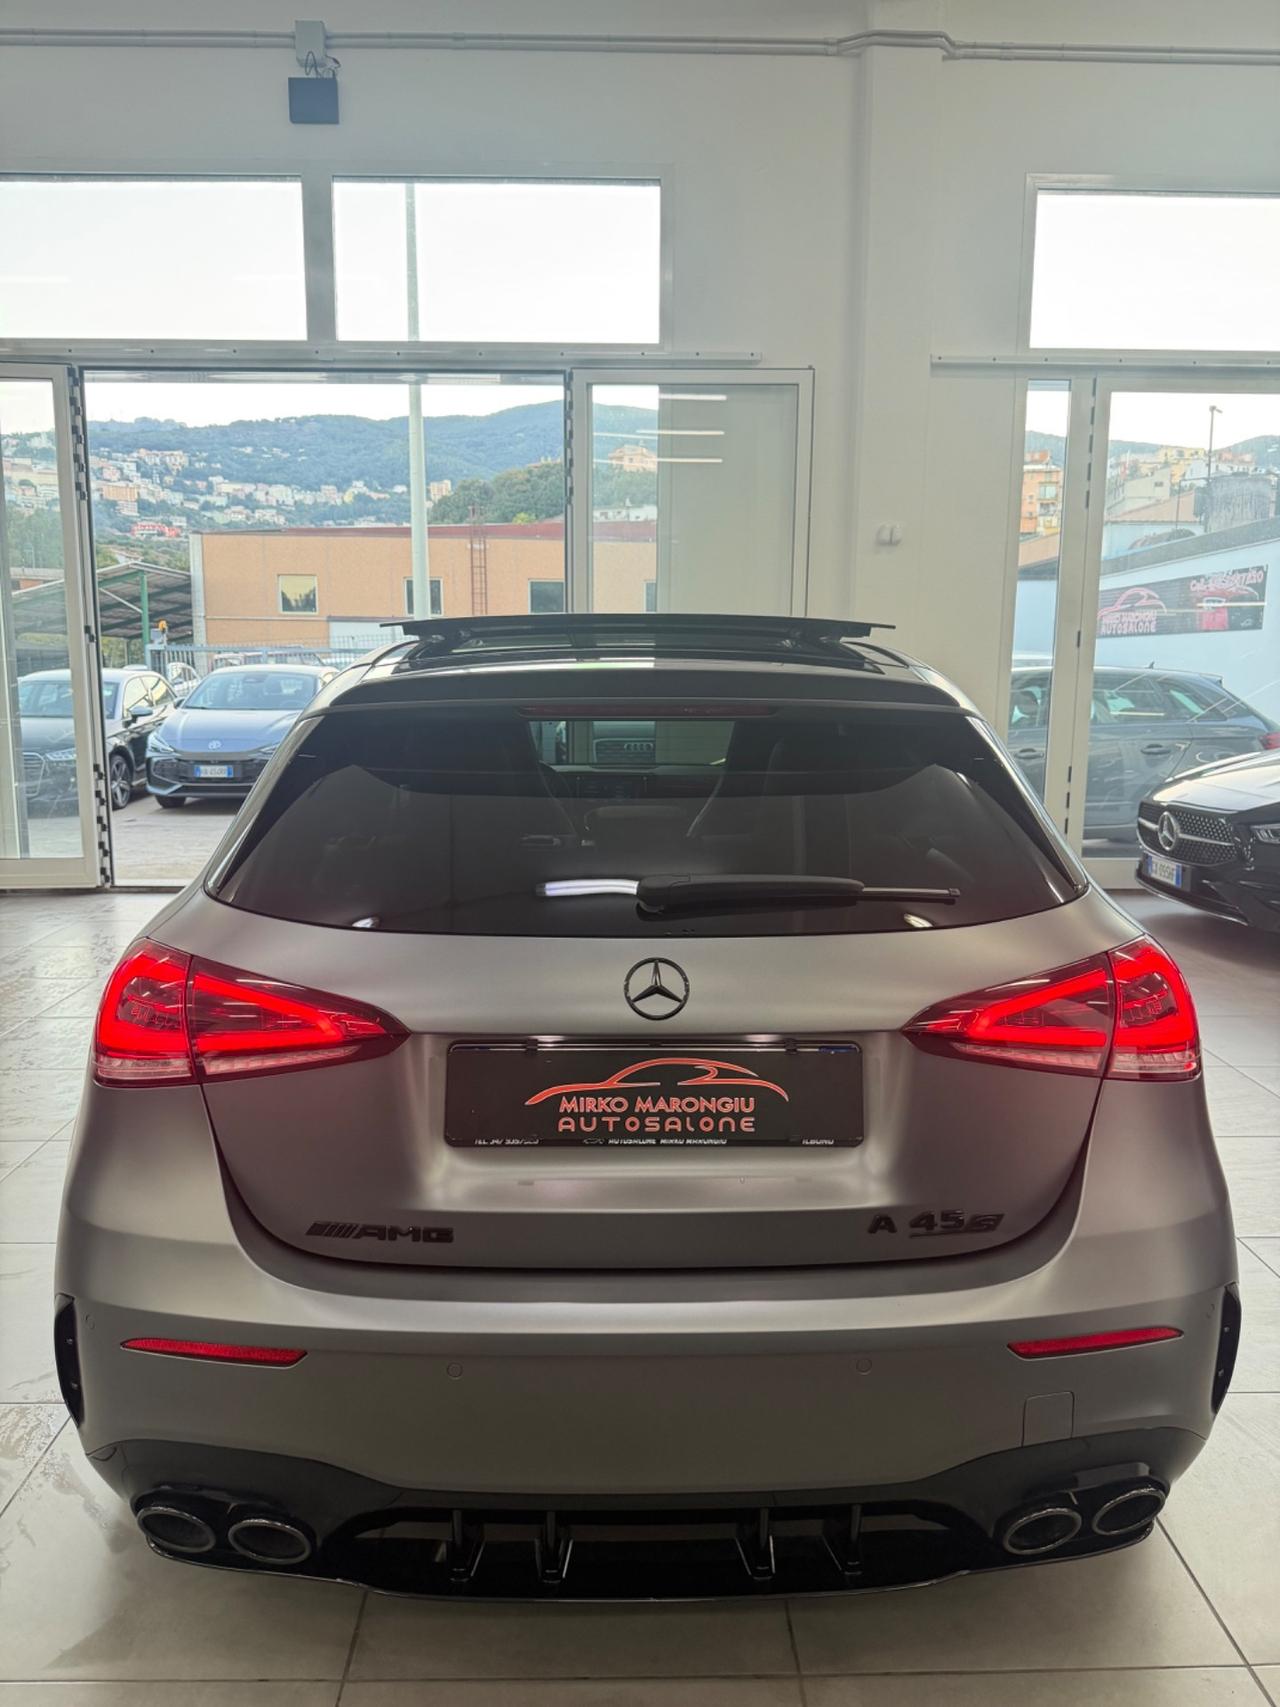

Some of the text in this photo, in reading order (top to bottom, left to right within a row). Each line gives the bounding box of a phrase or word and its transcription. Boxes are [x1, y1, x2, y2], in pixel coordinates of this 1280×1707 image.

[559, 1095, 756, 1113] MIRKO MARONGIU
[558, 1116, 756, 1132] AUTOSALONE
[350, 1221, 454, 1243] AMG
[868, 1213, 898, 1234] A
